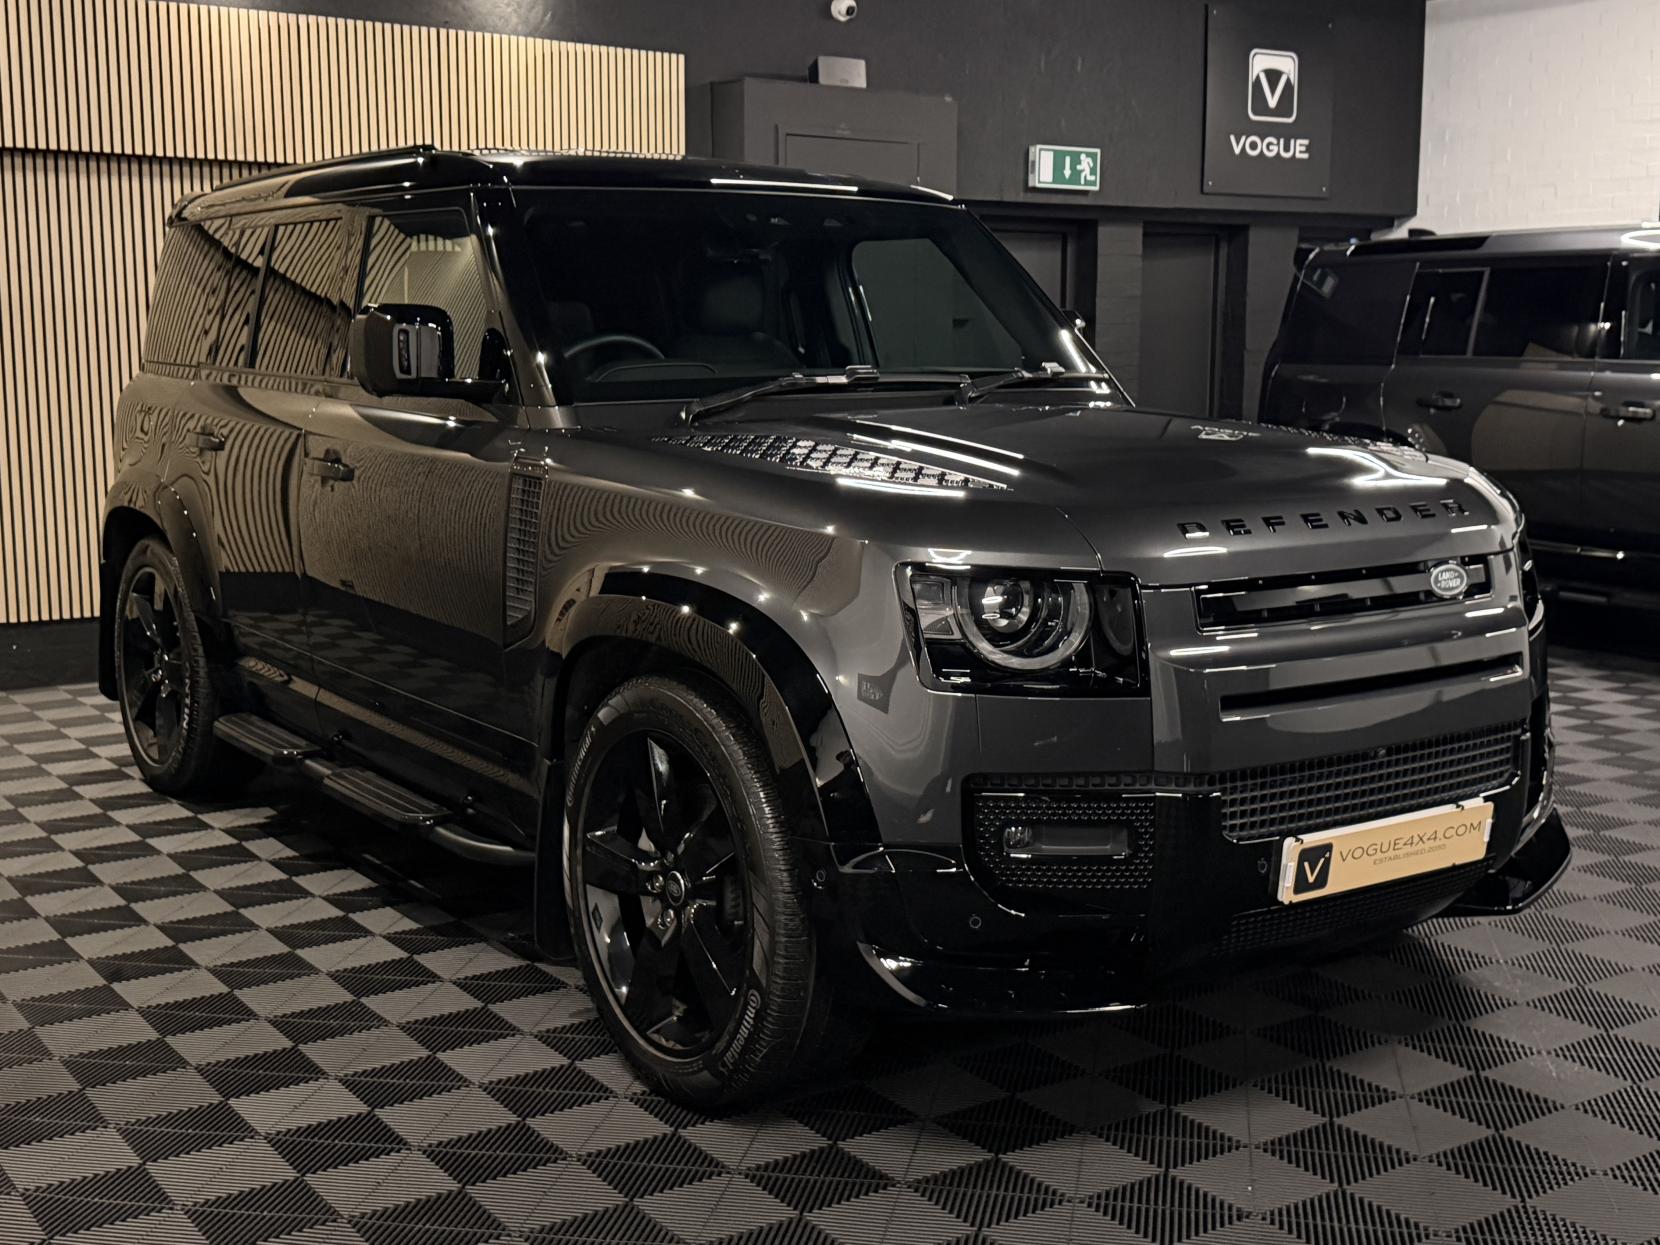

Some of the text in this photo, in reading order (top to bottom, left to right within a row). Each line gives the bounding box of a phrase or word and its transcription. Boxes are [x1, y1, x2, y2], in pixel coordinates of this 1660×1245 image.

[1258, 71, 1288, 109] V
[1229, 134, 1310, 159] VOGUE
[1177, 500, 1469, 538] DEFENDER
[1438, 570, 1455, 581] LAND
[1339, 820, 1482, 863] VOGUE4X4.COM
[1304, 850, 1331, 883] V
